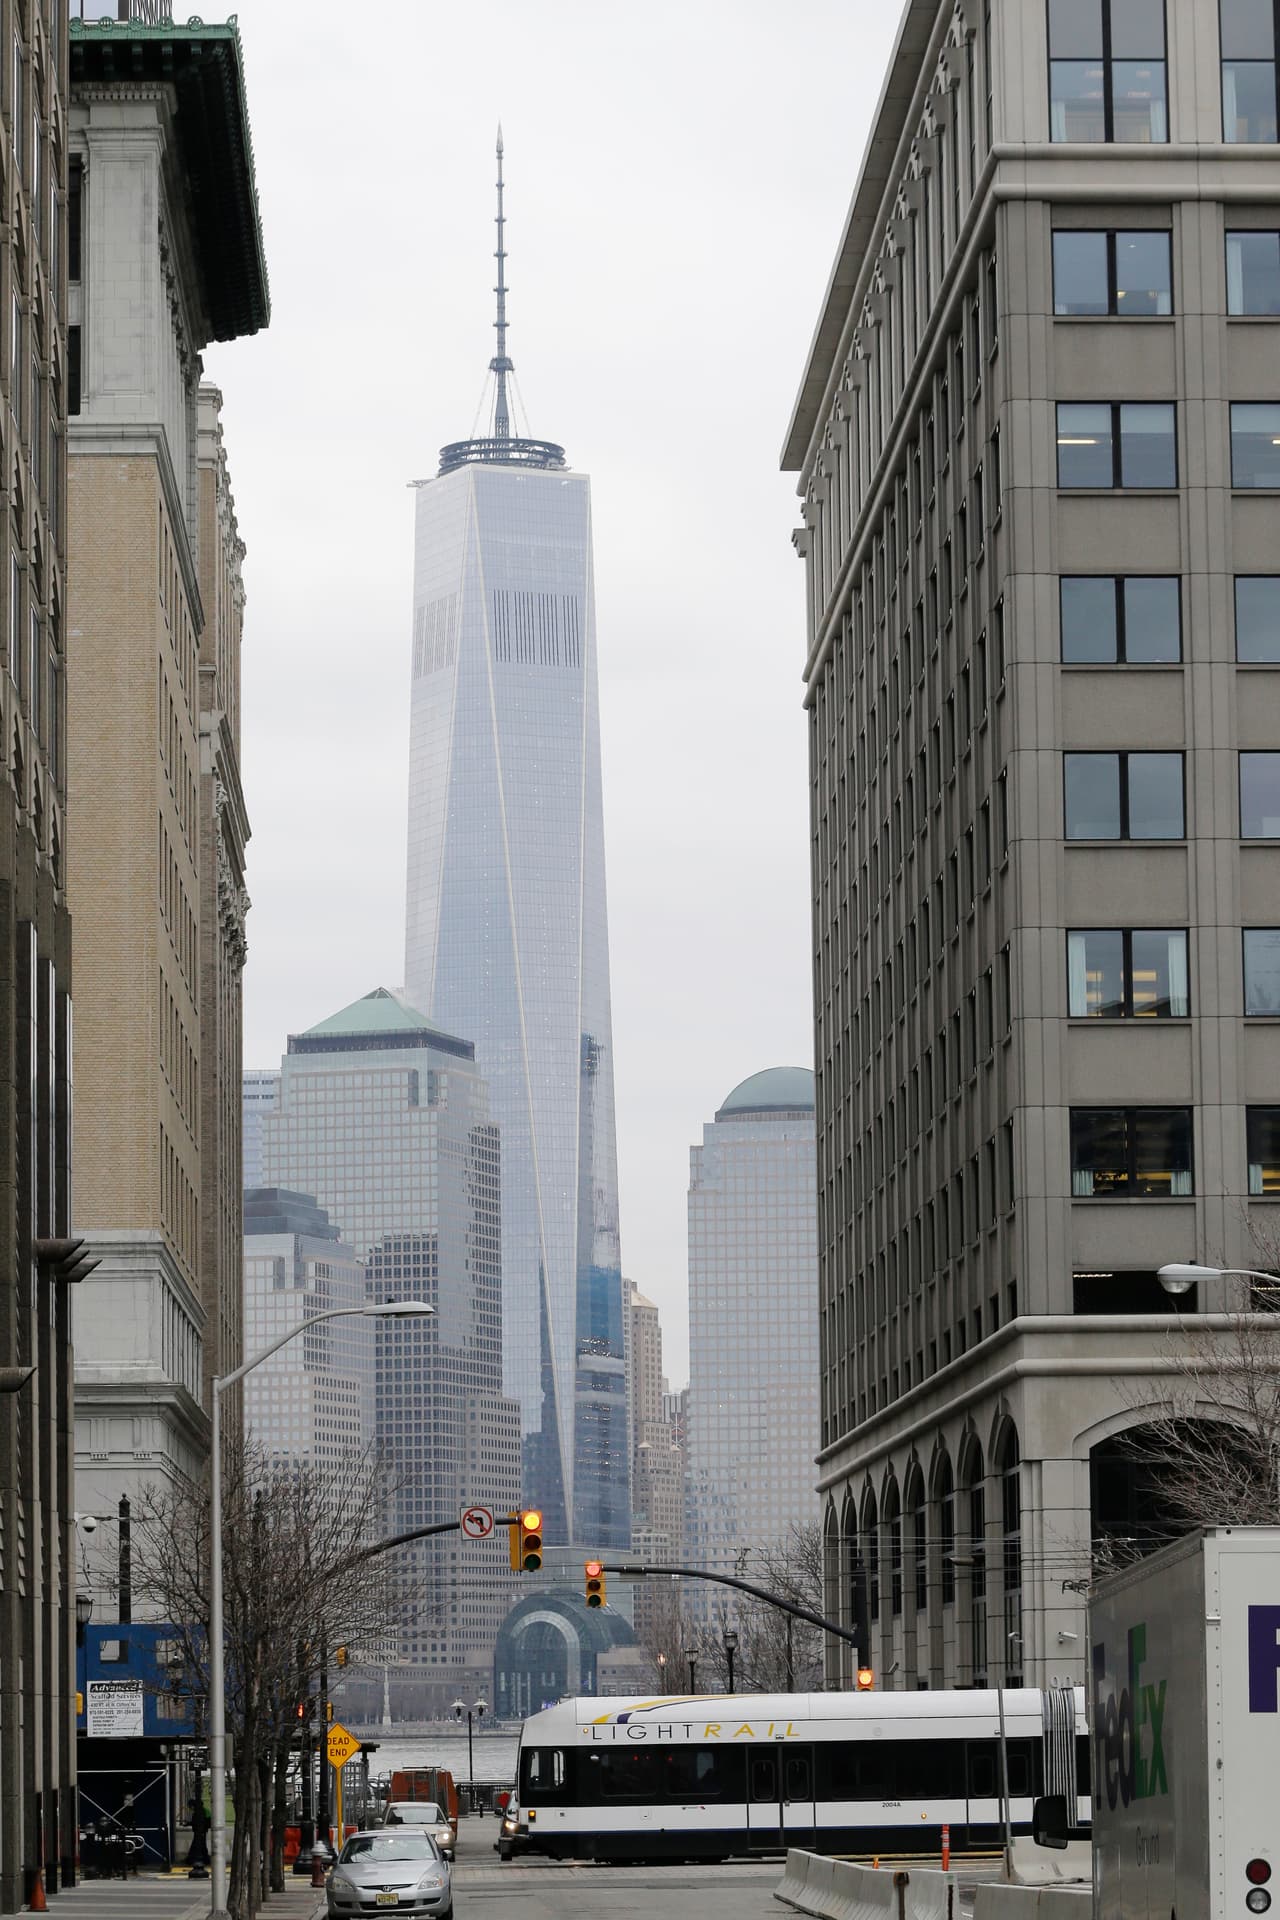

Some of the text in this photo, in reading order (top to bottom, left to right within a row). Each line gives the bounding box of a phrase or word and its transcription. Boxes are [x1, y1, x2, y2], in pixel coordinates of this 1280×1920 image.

[1093, 1622, 1168, 1812] FedEx
[592, 1722, 800, 1740] LIGHT RAIL
[327, 1737, 350, 1745] DEAD
[330, 1748, 347, 1756] END
